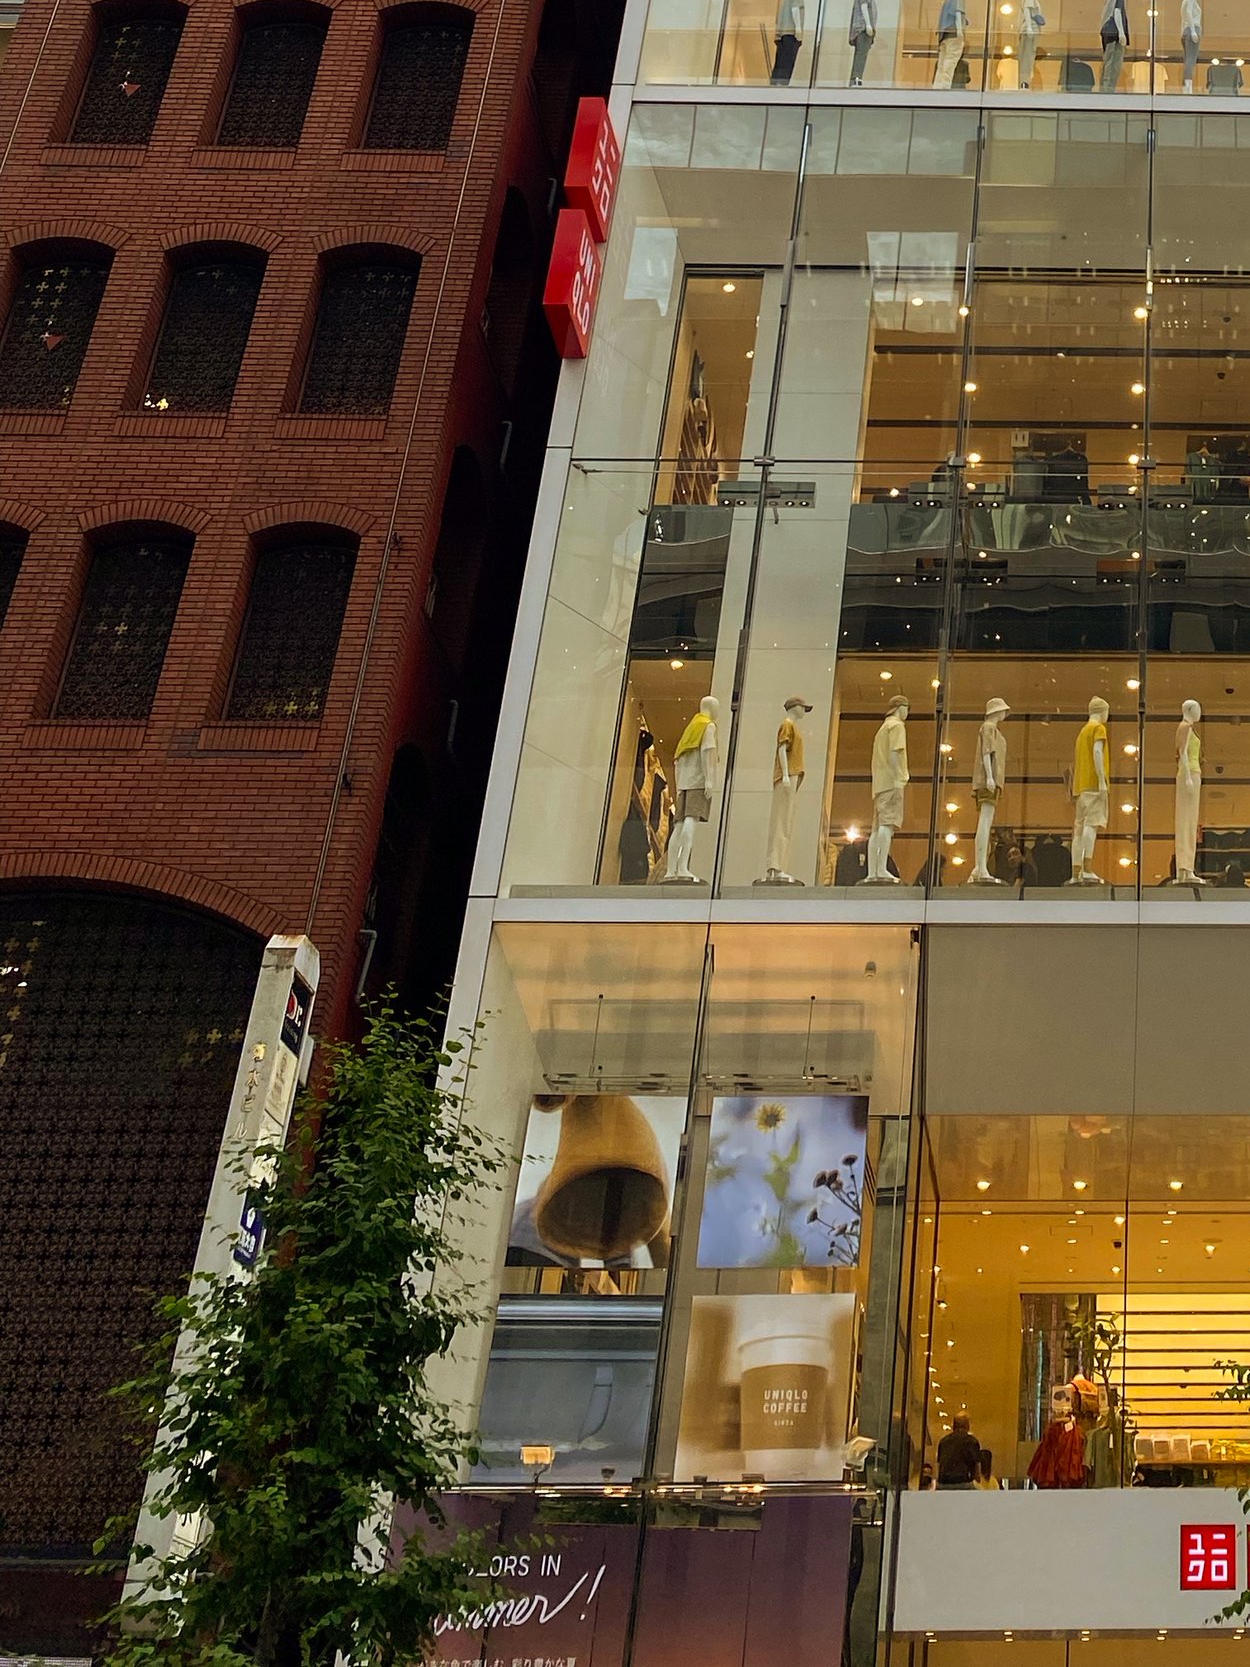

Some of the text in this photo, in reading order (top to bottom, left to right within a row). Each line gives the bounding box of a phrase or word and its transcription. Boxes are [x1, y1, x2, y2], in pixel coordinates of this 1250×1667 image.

[764, 1390, 808, 1401] UNIQLO
[763, 1402, 808, 1413] COFFEE
[1188, 1533, 1228, 1555] ユニ
[541, 1554, 561, 1577] IN
[1187, 1560, 1228, 1582] クロ
